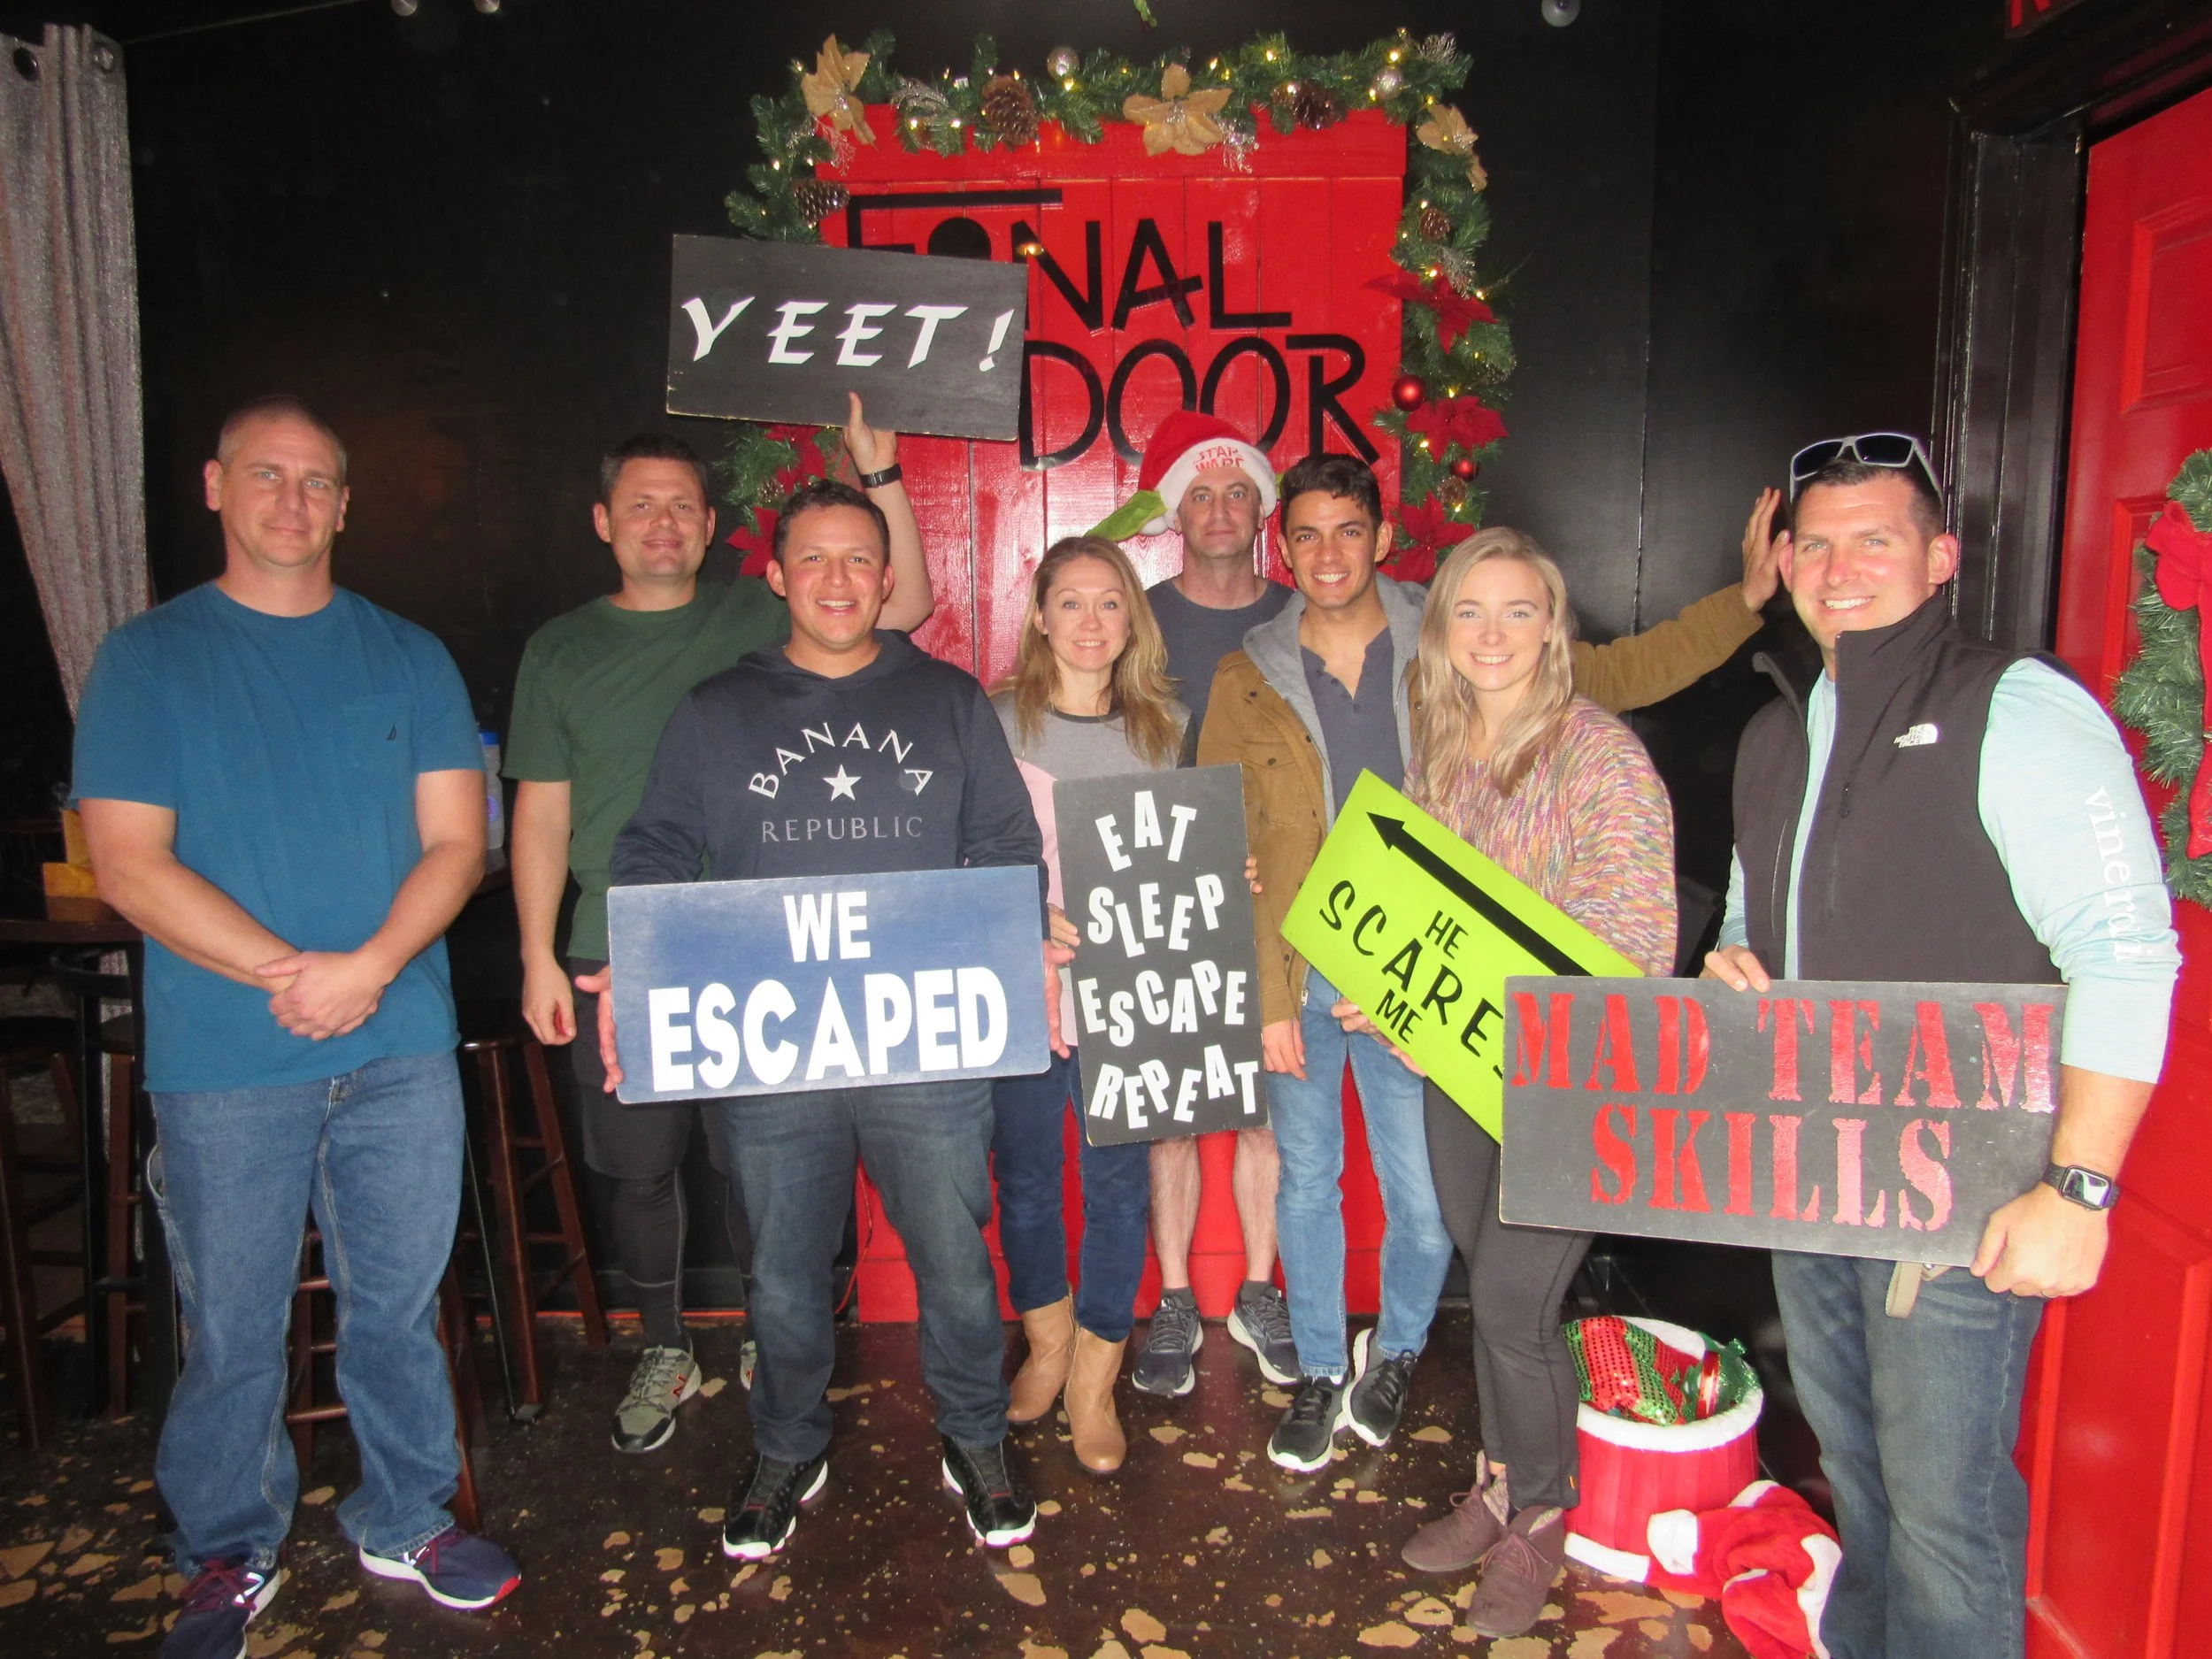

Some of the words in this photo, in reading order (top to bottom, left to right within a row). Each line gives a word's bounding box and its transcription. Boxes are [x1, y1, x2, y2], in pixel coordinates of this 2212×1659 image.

[680, 296, 1016, 373] YEET!
[1020, 334, 1380, 472] DOOR
[749, 722, 933, 800] BANANA
[762, 816, 924, 843] REPUBLIC
[1094, 789, 1198, 872] EAT
[782, 890, 872, 963] WE
[1087, 873, 1225, 958] SLEEP
[1425, 910, 1469, 960] HE
[1077, 959, 1247, 1048] ESCAPE
[1318, 879, 1504, 1081] SCARE
[1374, 989, 1423, 1045] ME
[648, 966, 1009, 1093] ESCAPED
[1510, 991, 1711, 1096] MAD
[1756, 996, 2055, 1114] TEAM
[1088, 1043, 1259, 1130] REPEAT
[1590, 1102, 1955, 1232] SKILLS
